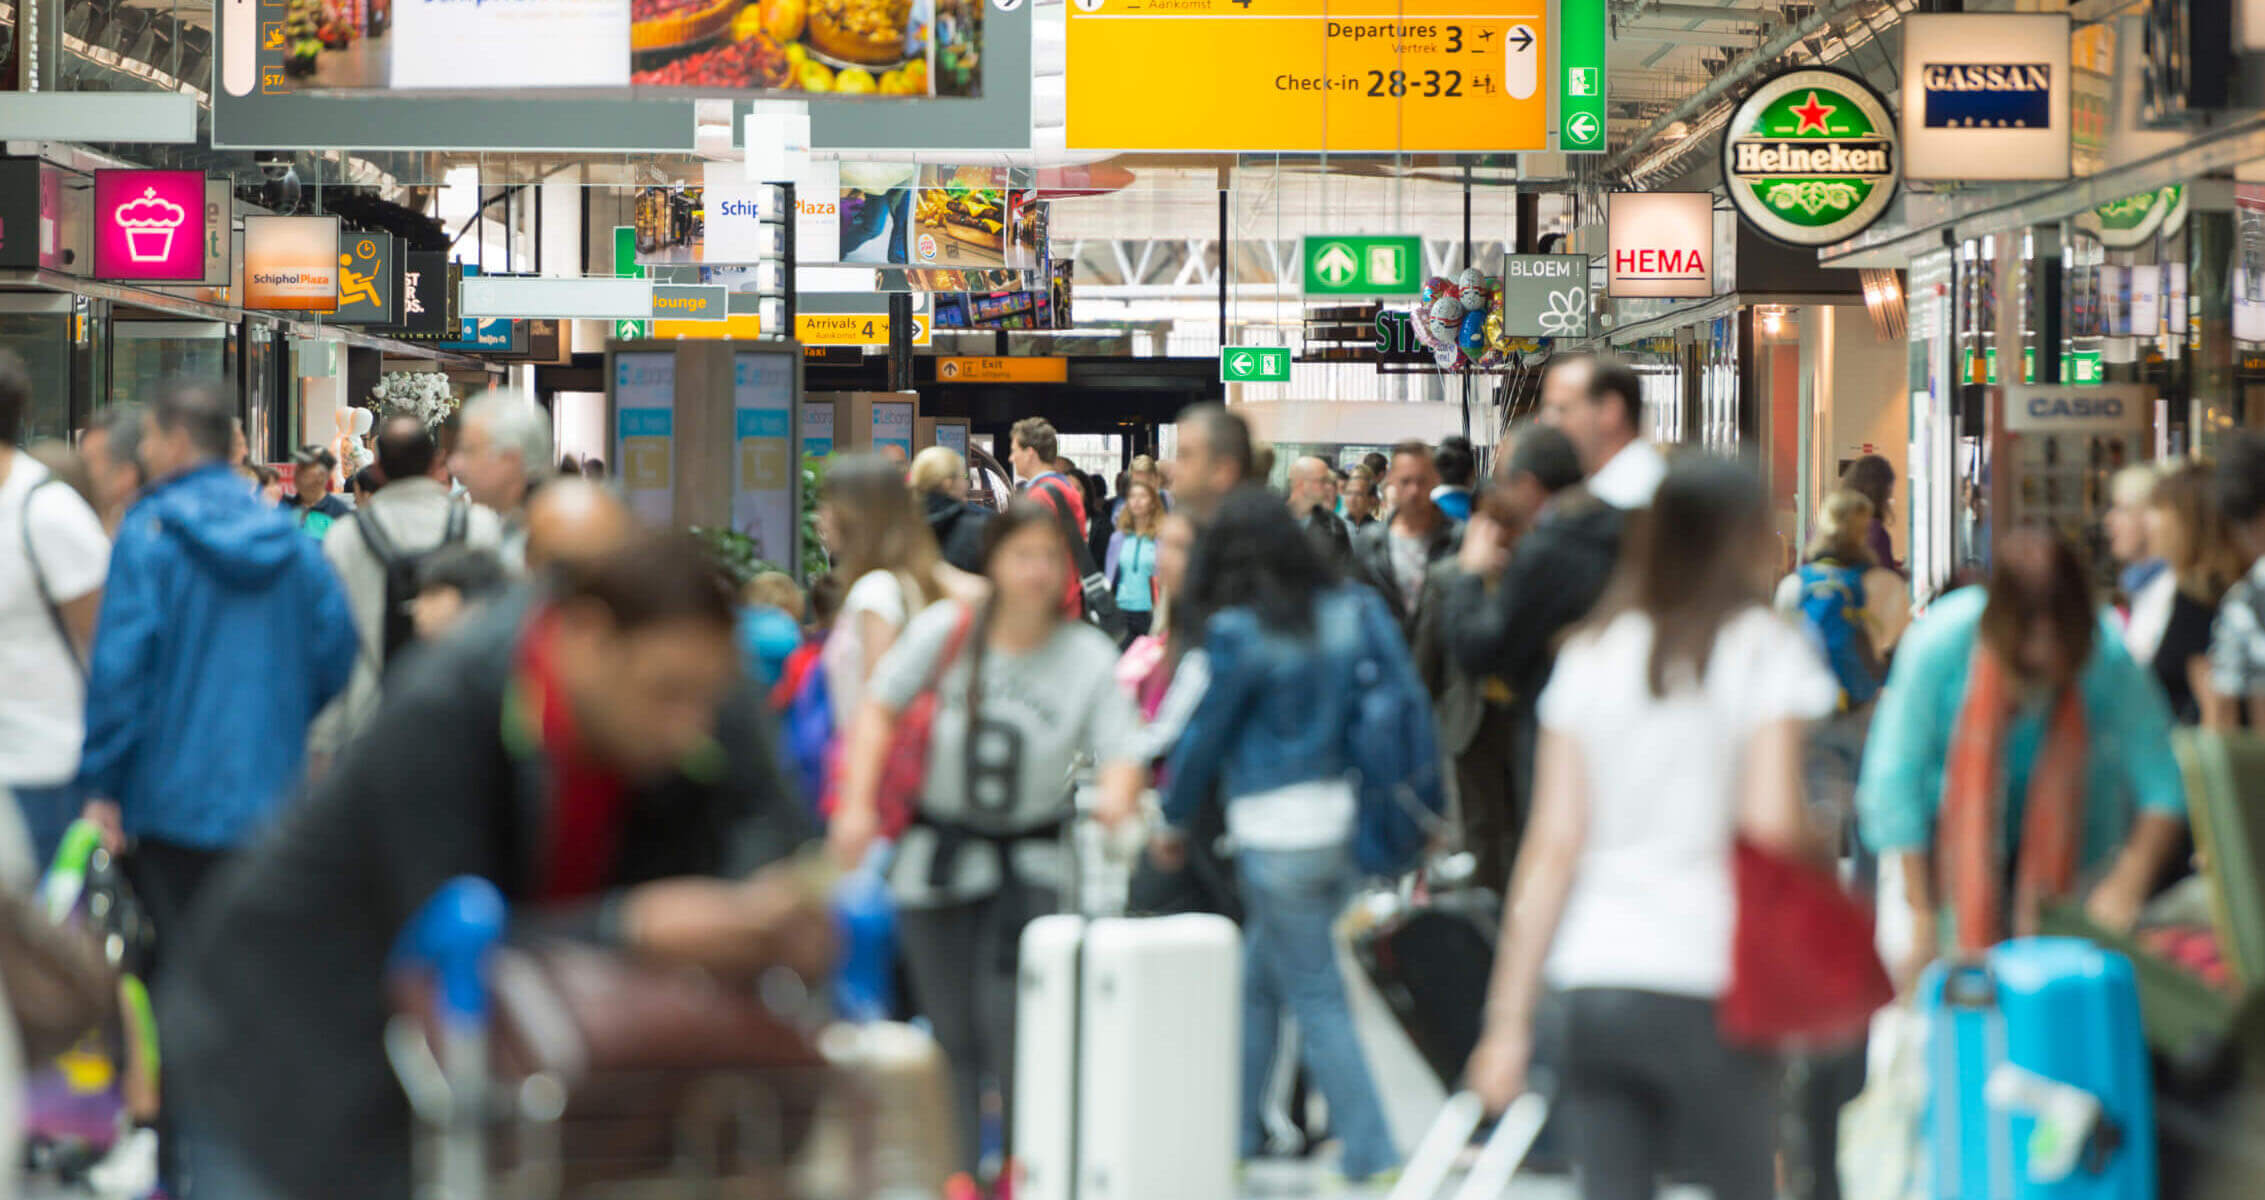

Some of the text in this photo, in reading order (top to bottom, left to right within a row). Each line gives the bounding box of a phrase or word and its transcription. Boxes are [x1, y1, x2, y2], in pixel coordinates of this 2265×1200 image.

[1327, 23, 1463, 53] Departures 3
[1392, 43, 1437, 54] Vertrek
[1275, 70, 1463, 97] Check-in 28-32
[1925, 65, 2049, 92] GASSAN
[1736, 143, 1886, 173] Heineken
[1510, 260, 1570, 277] BLOEM
[1616, 249, 1704, 273] HEMA
[653, 294, 707, 312] lounge
[806, 317, 875, 338] Arrivals 4
[803, 346, 826, 357] Taxi
[982, 358, 1004, 369] Exit
[2027, 397, 2123, 418] CASIO
